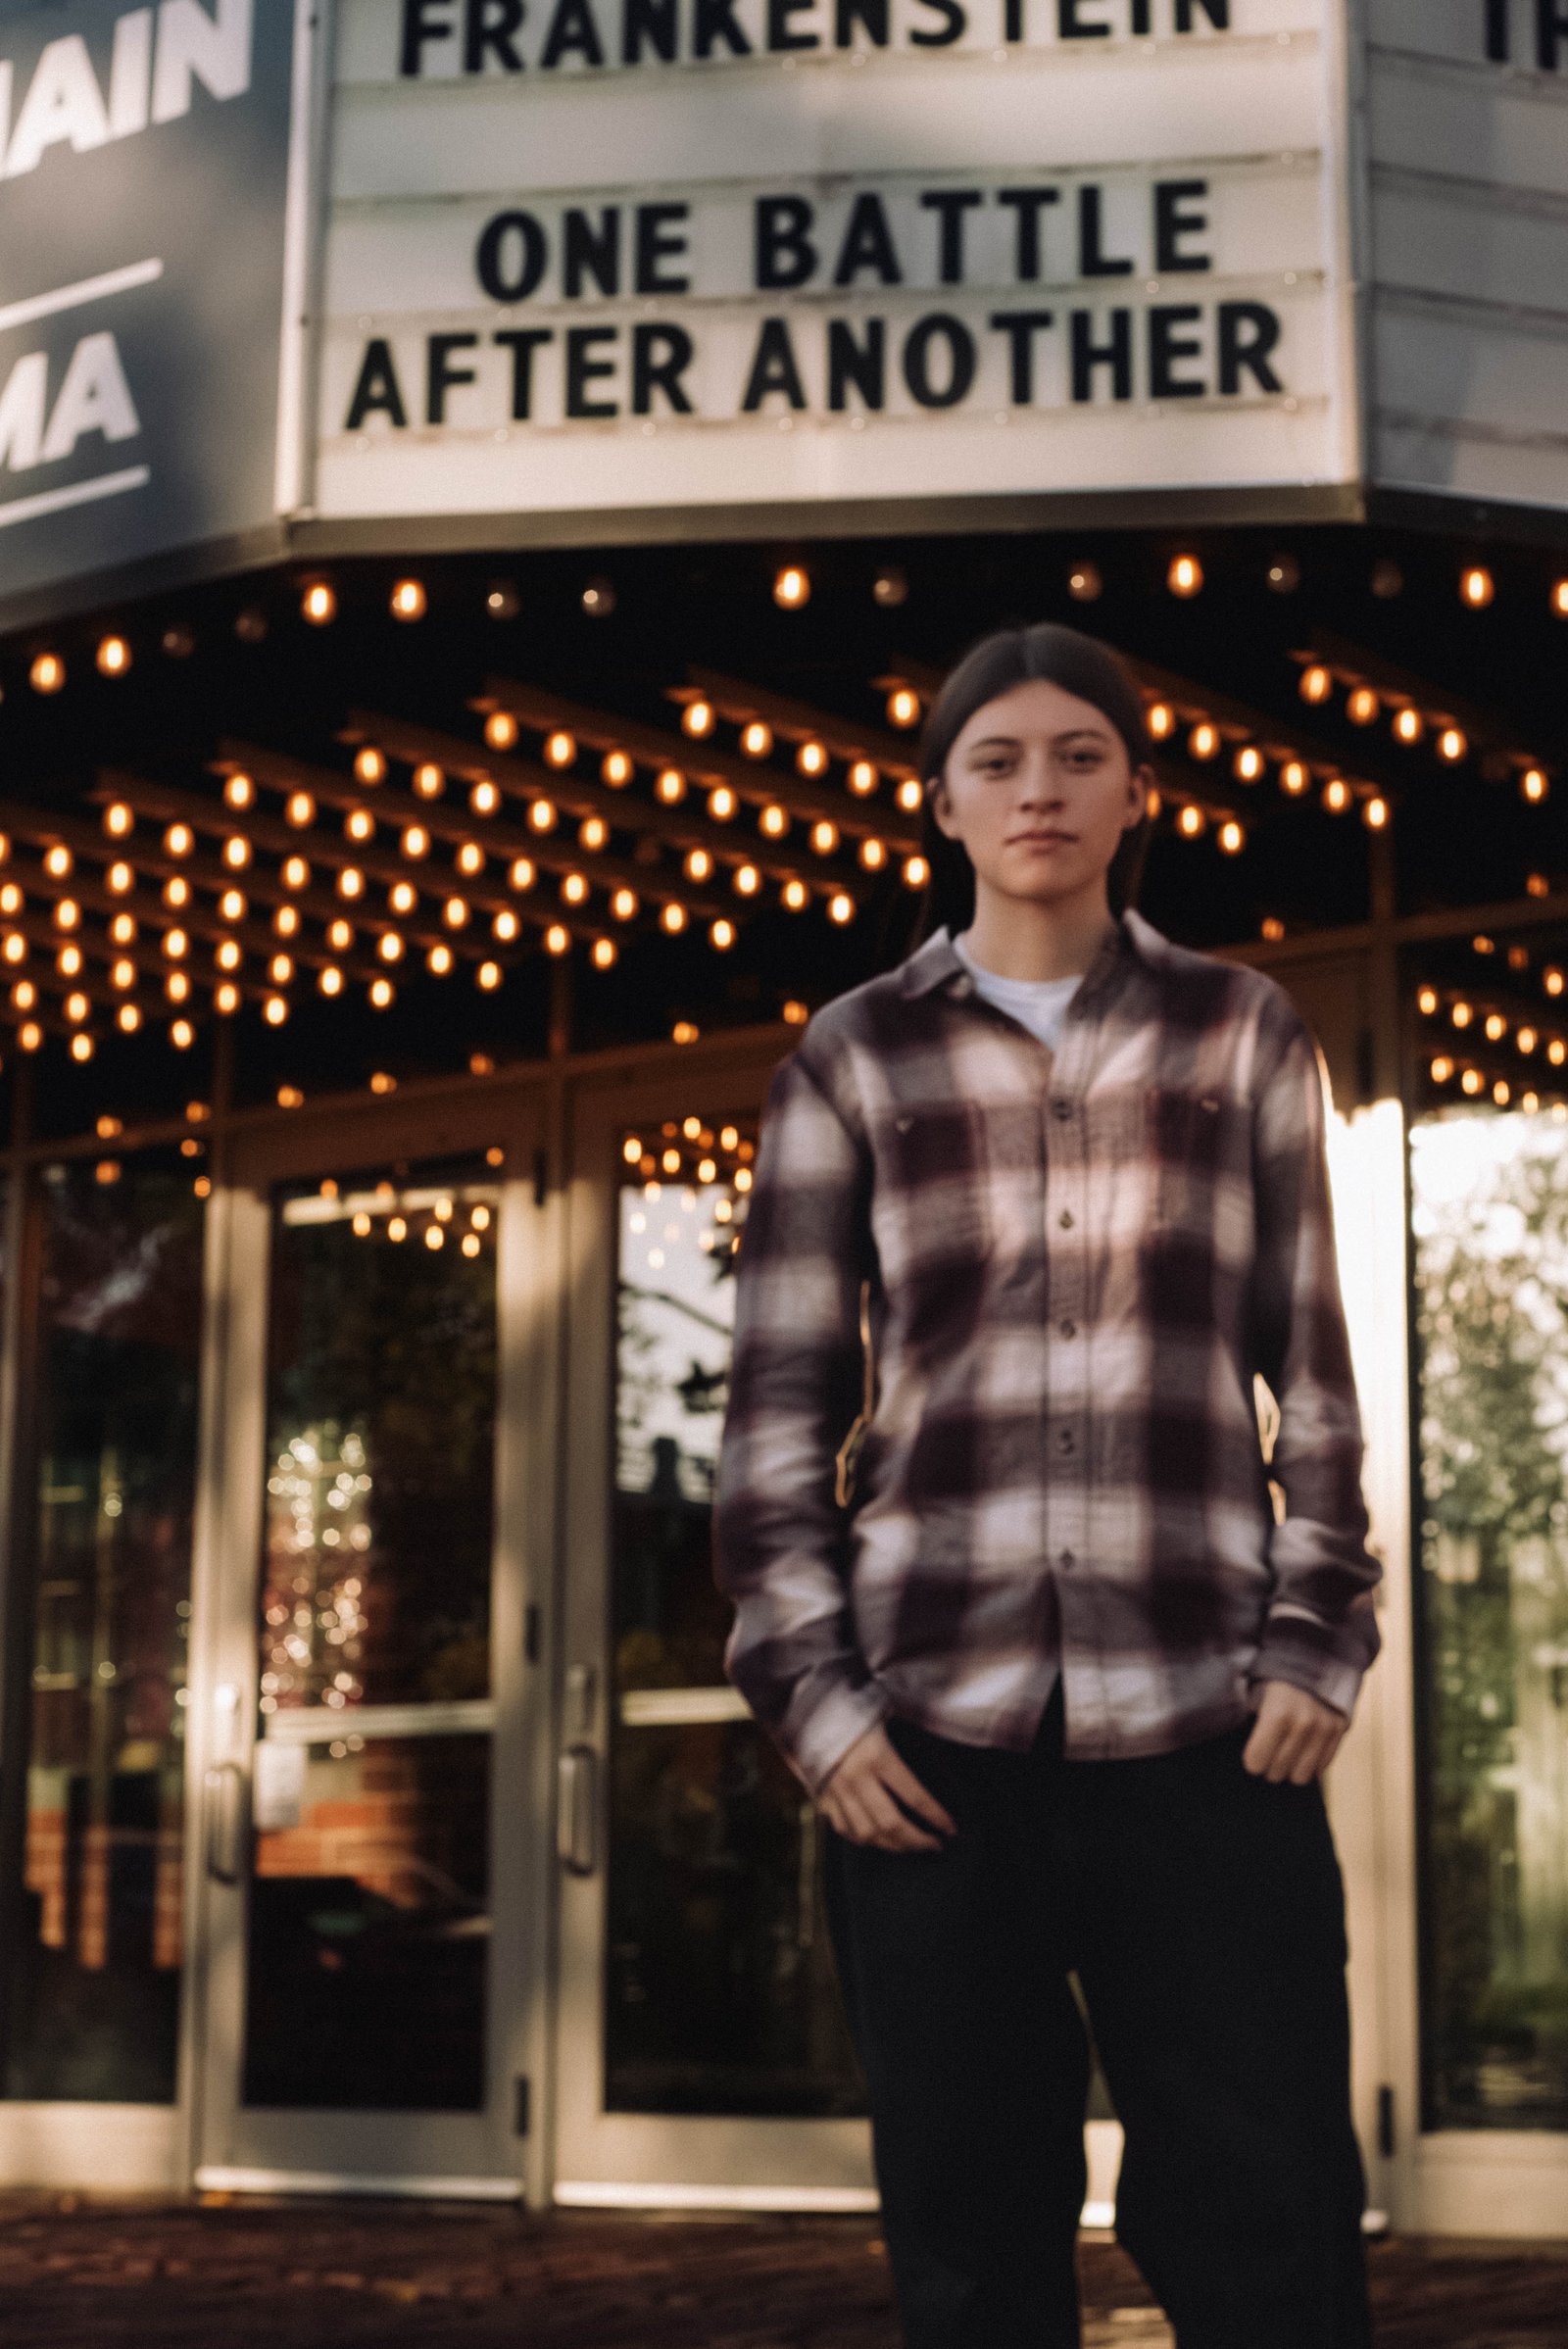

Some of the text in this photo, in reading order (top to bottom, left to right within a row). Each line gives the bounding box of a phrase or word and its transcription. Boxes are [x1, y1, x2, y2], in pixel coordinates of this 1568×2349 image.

[0, 0, 253, 180] AIN
[474, 180, 1213, 305] ONE BATTLE
[344, 301, 1285, 431] AFTER ANOTHER
